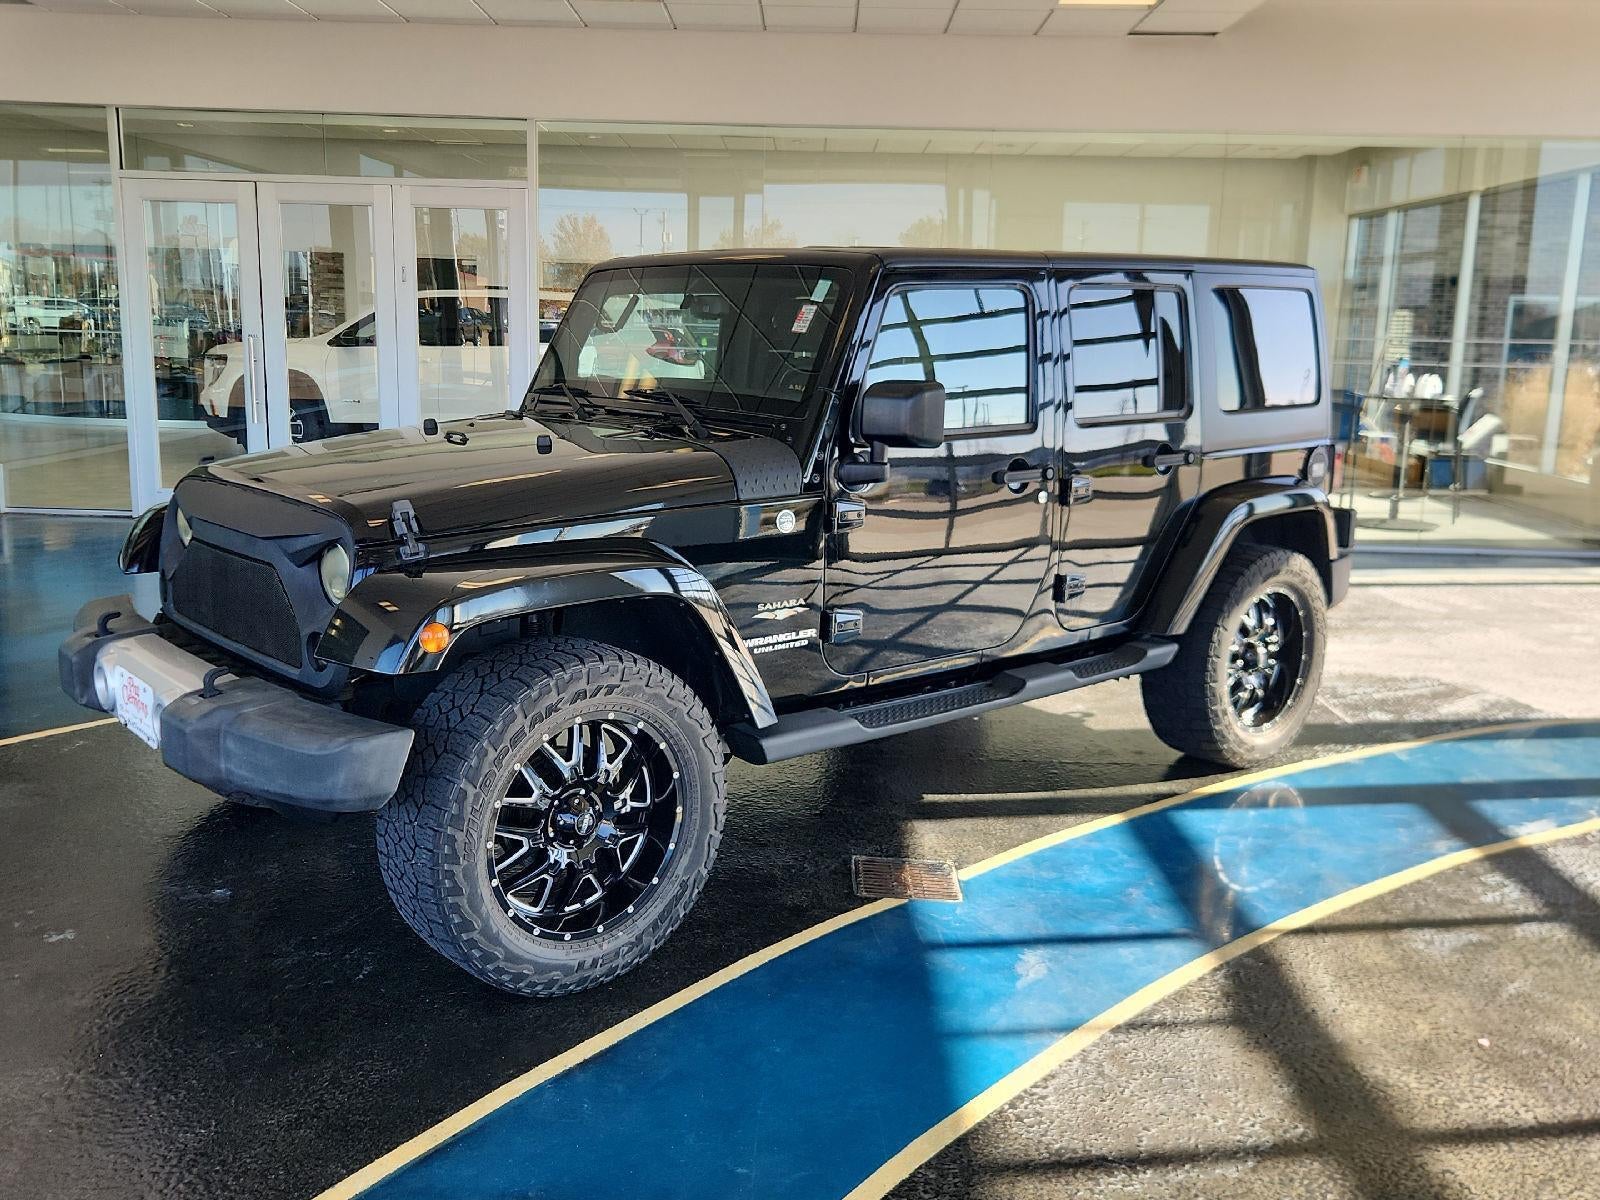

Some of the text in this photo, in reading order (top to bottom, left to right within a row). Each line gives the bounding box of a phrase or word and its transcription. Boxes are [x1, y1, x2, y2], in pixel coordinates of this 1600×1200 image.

[757, 598, 806, 611] SAHARA
[742, 628, 818, 648] WRANGLER
[753, 639, 809, 654] UNLIMITED
